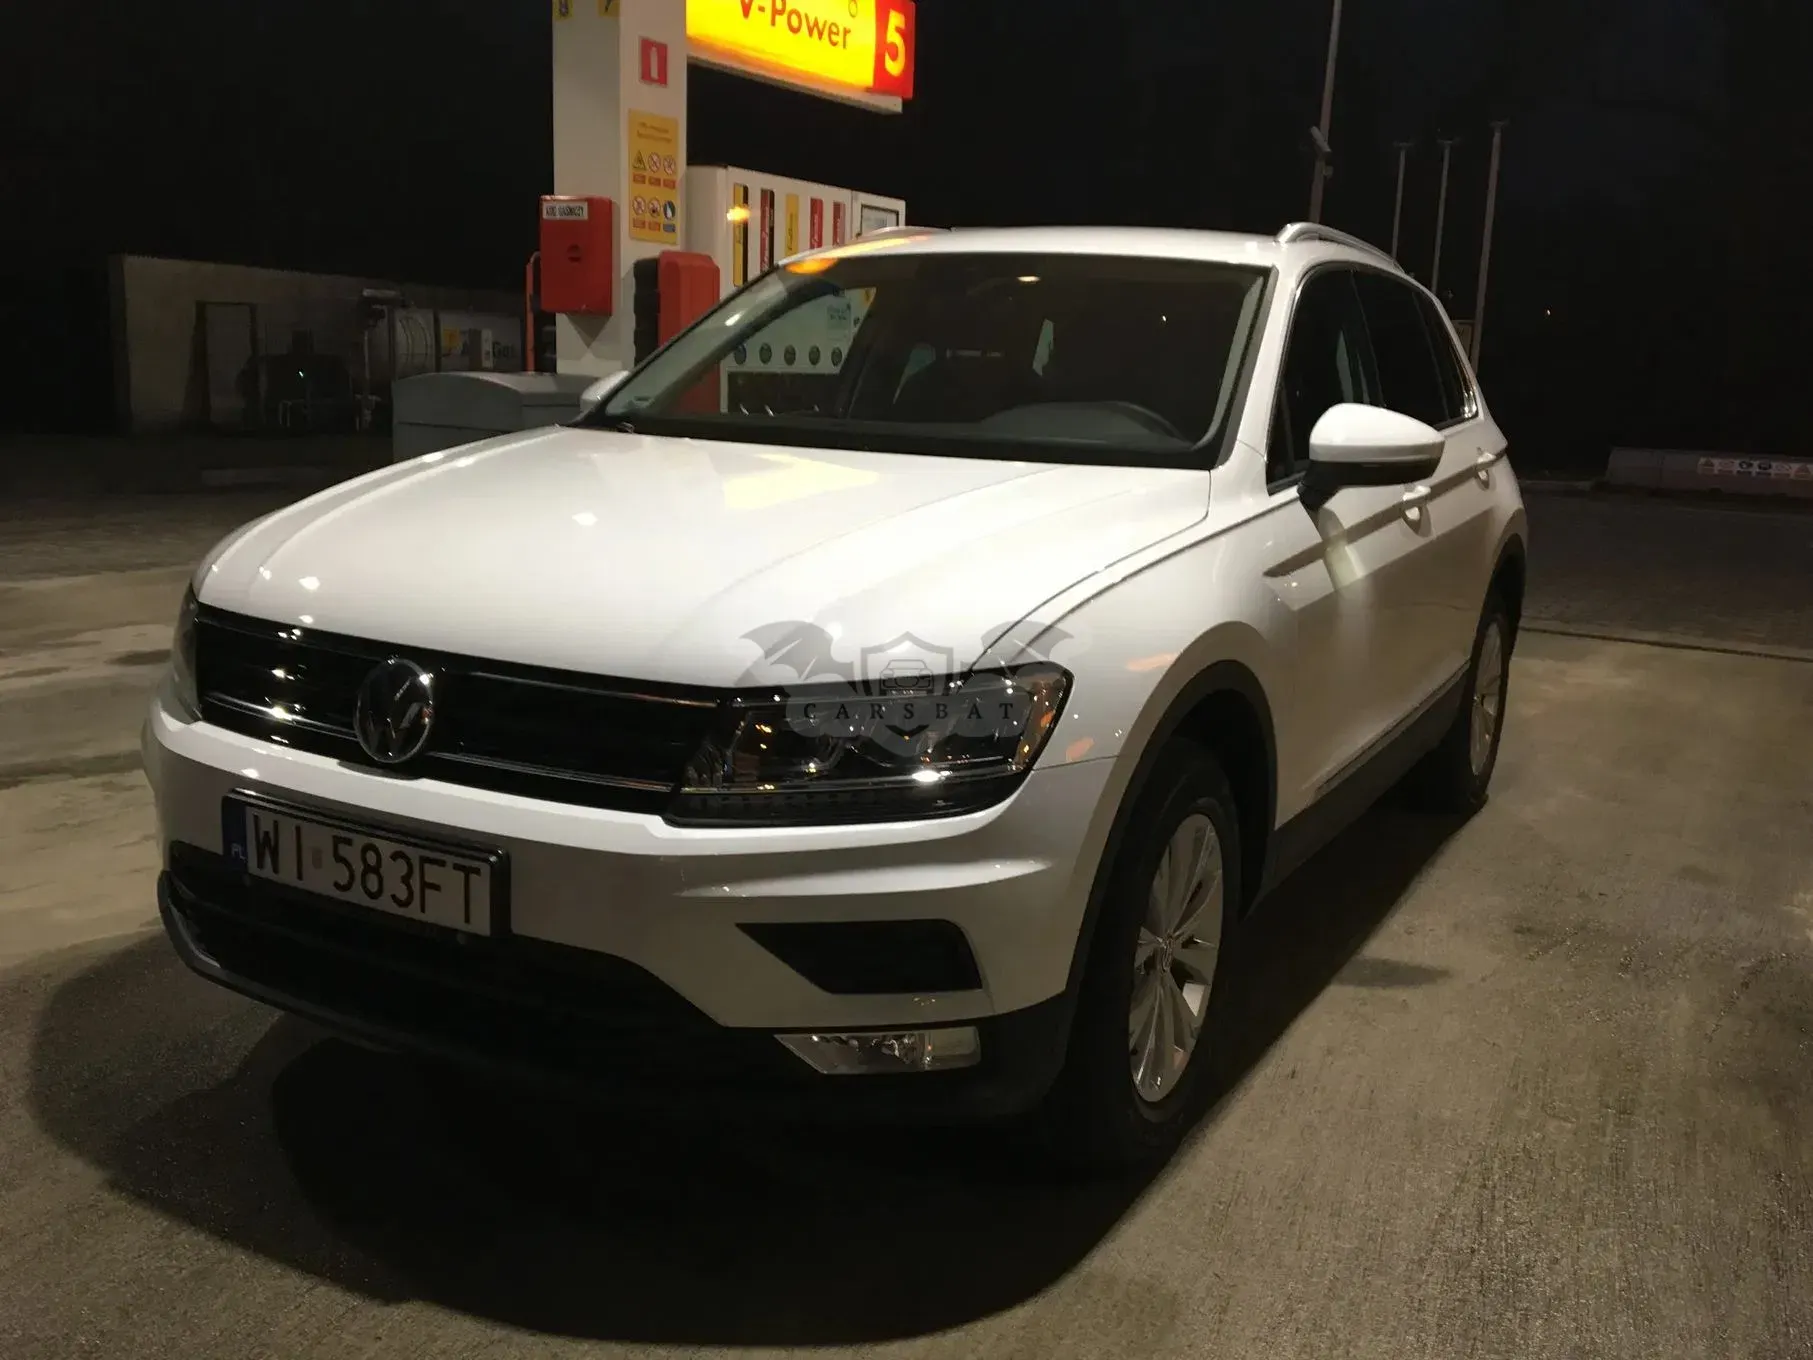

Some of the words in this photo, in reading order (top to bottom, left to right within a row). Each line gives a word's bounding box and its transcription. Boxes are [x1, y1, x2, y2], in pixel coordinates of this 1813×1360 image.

[884, 8, 905, 77] 5
[252, 814, 304, 880] WI
[332, 834, 481, 924] 583FT
